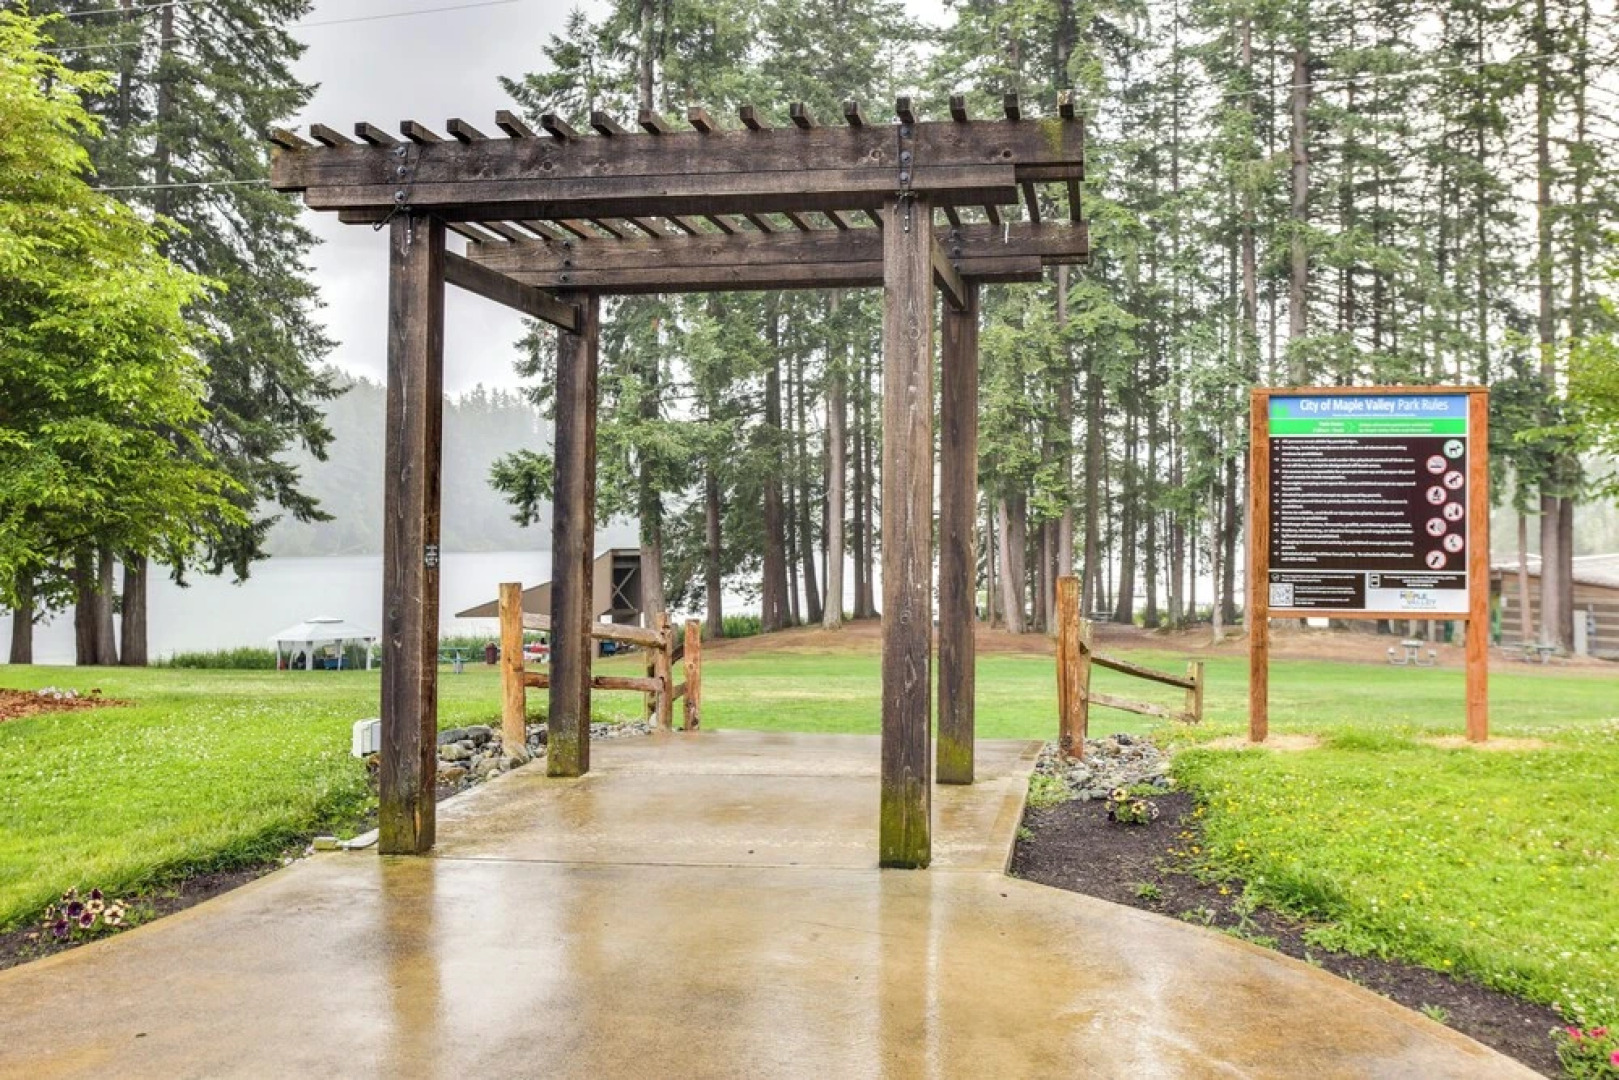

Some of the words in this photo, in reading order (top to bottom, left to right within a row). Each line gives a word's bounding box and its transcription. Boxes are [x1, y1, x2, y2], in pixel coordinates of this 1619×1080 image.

[1299, 399, 1319, 413] City
[1320, 399, 1330, 411] of
[1332, 399, 1364, 412] Maple
[1365, 399, 1395, 413] Valley
[1398, 400, 1419, 411] Park
[1421, 400, 1449, 411] Rules
